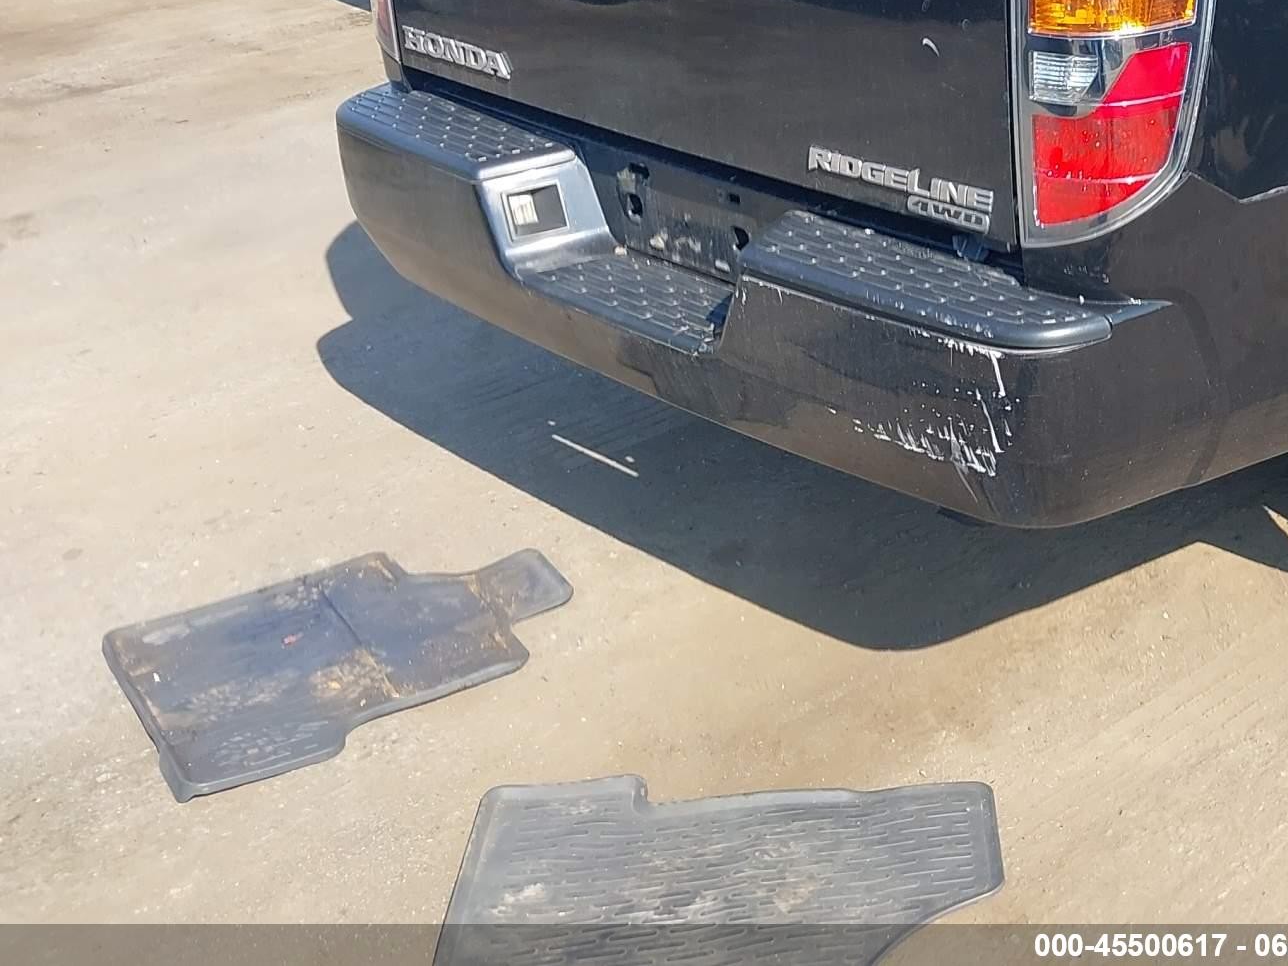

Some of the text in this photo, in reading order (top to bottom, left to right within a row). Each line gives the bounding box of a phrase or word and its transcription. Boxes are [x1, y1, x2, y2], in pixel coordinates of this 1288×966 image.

[402, 25, 513, 80] HONDA
[808, 145, 994, 212] RIDGELINE
[907, 194, 991, 234] 4WD
